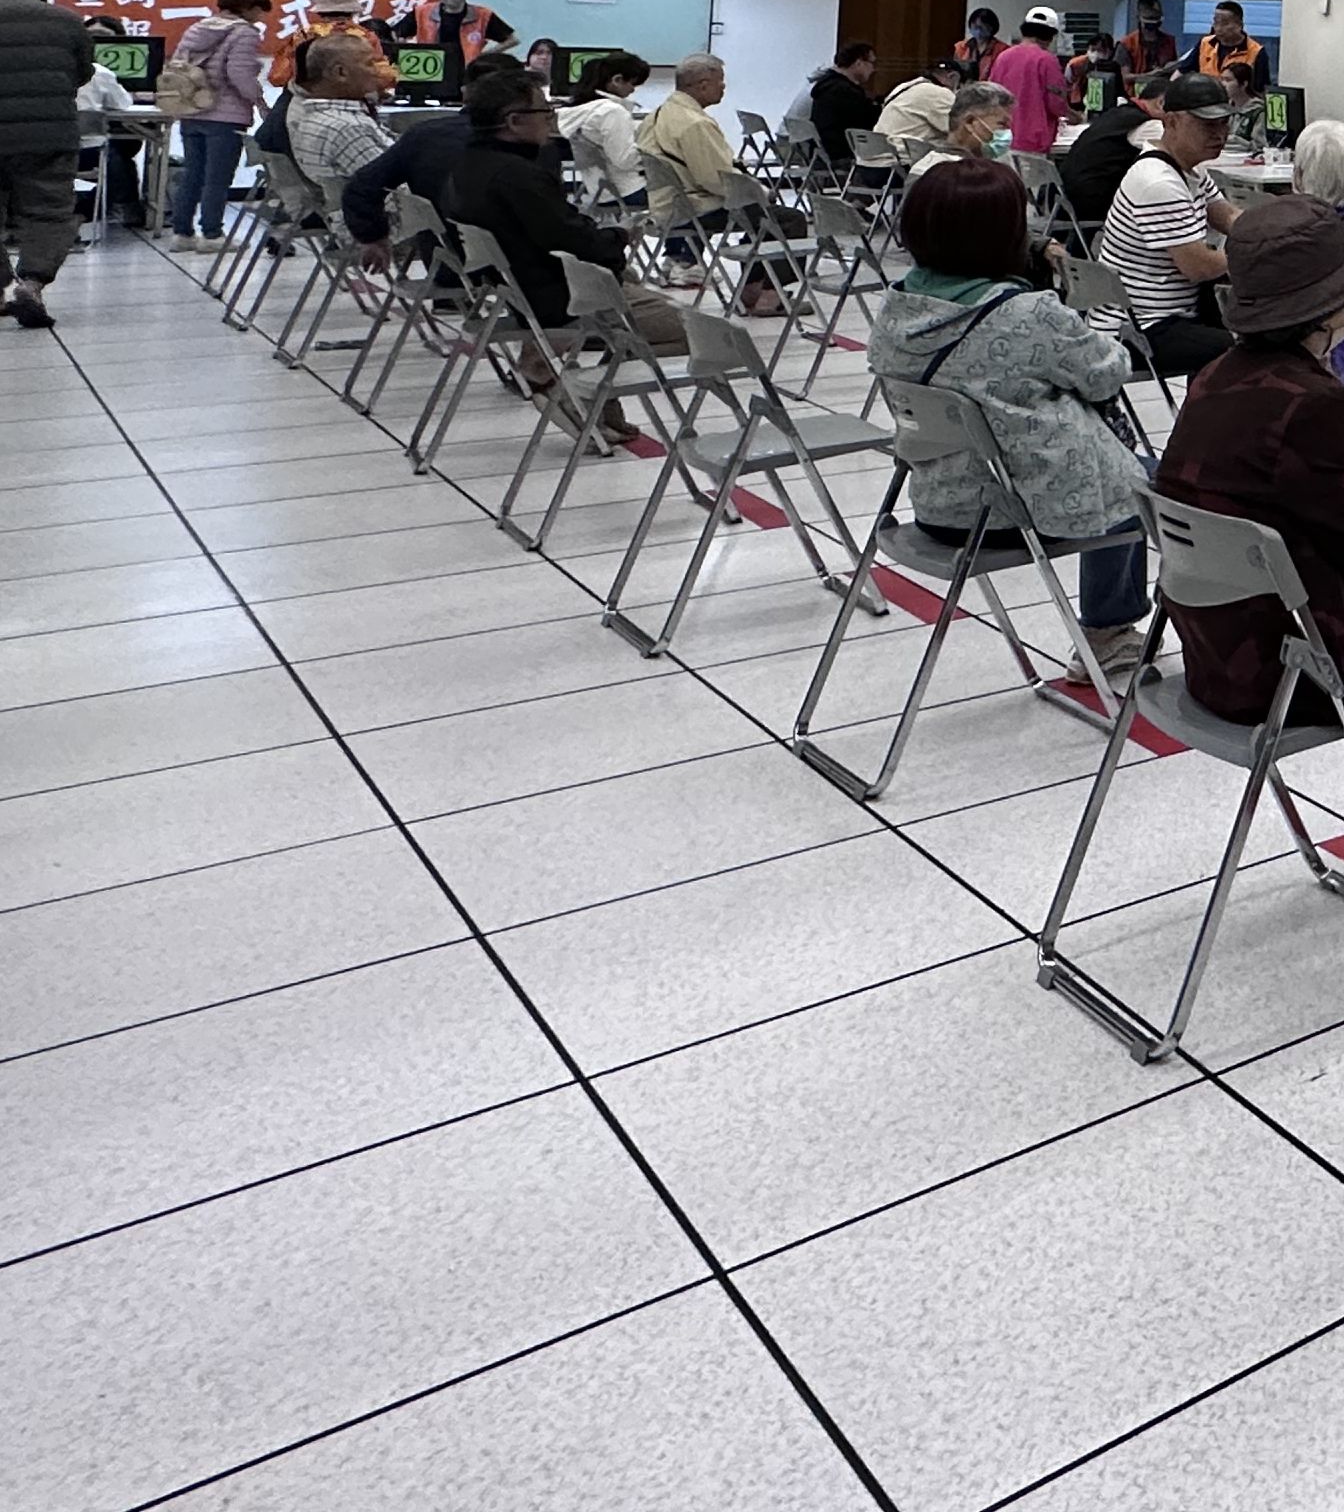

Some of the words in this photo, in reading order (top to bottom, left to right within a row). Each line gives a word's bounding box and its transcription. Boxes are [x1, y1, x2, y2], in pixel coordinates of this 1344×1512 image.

[103, 50, 141, 73] 21
[405, 55, 438, 75] 20
[1268, 100, 1285, 124] 14
